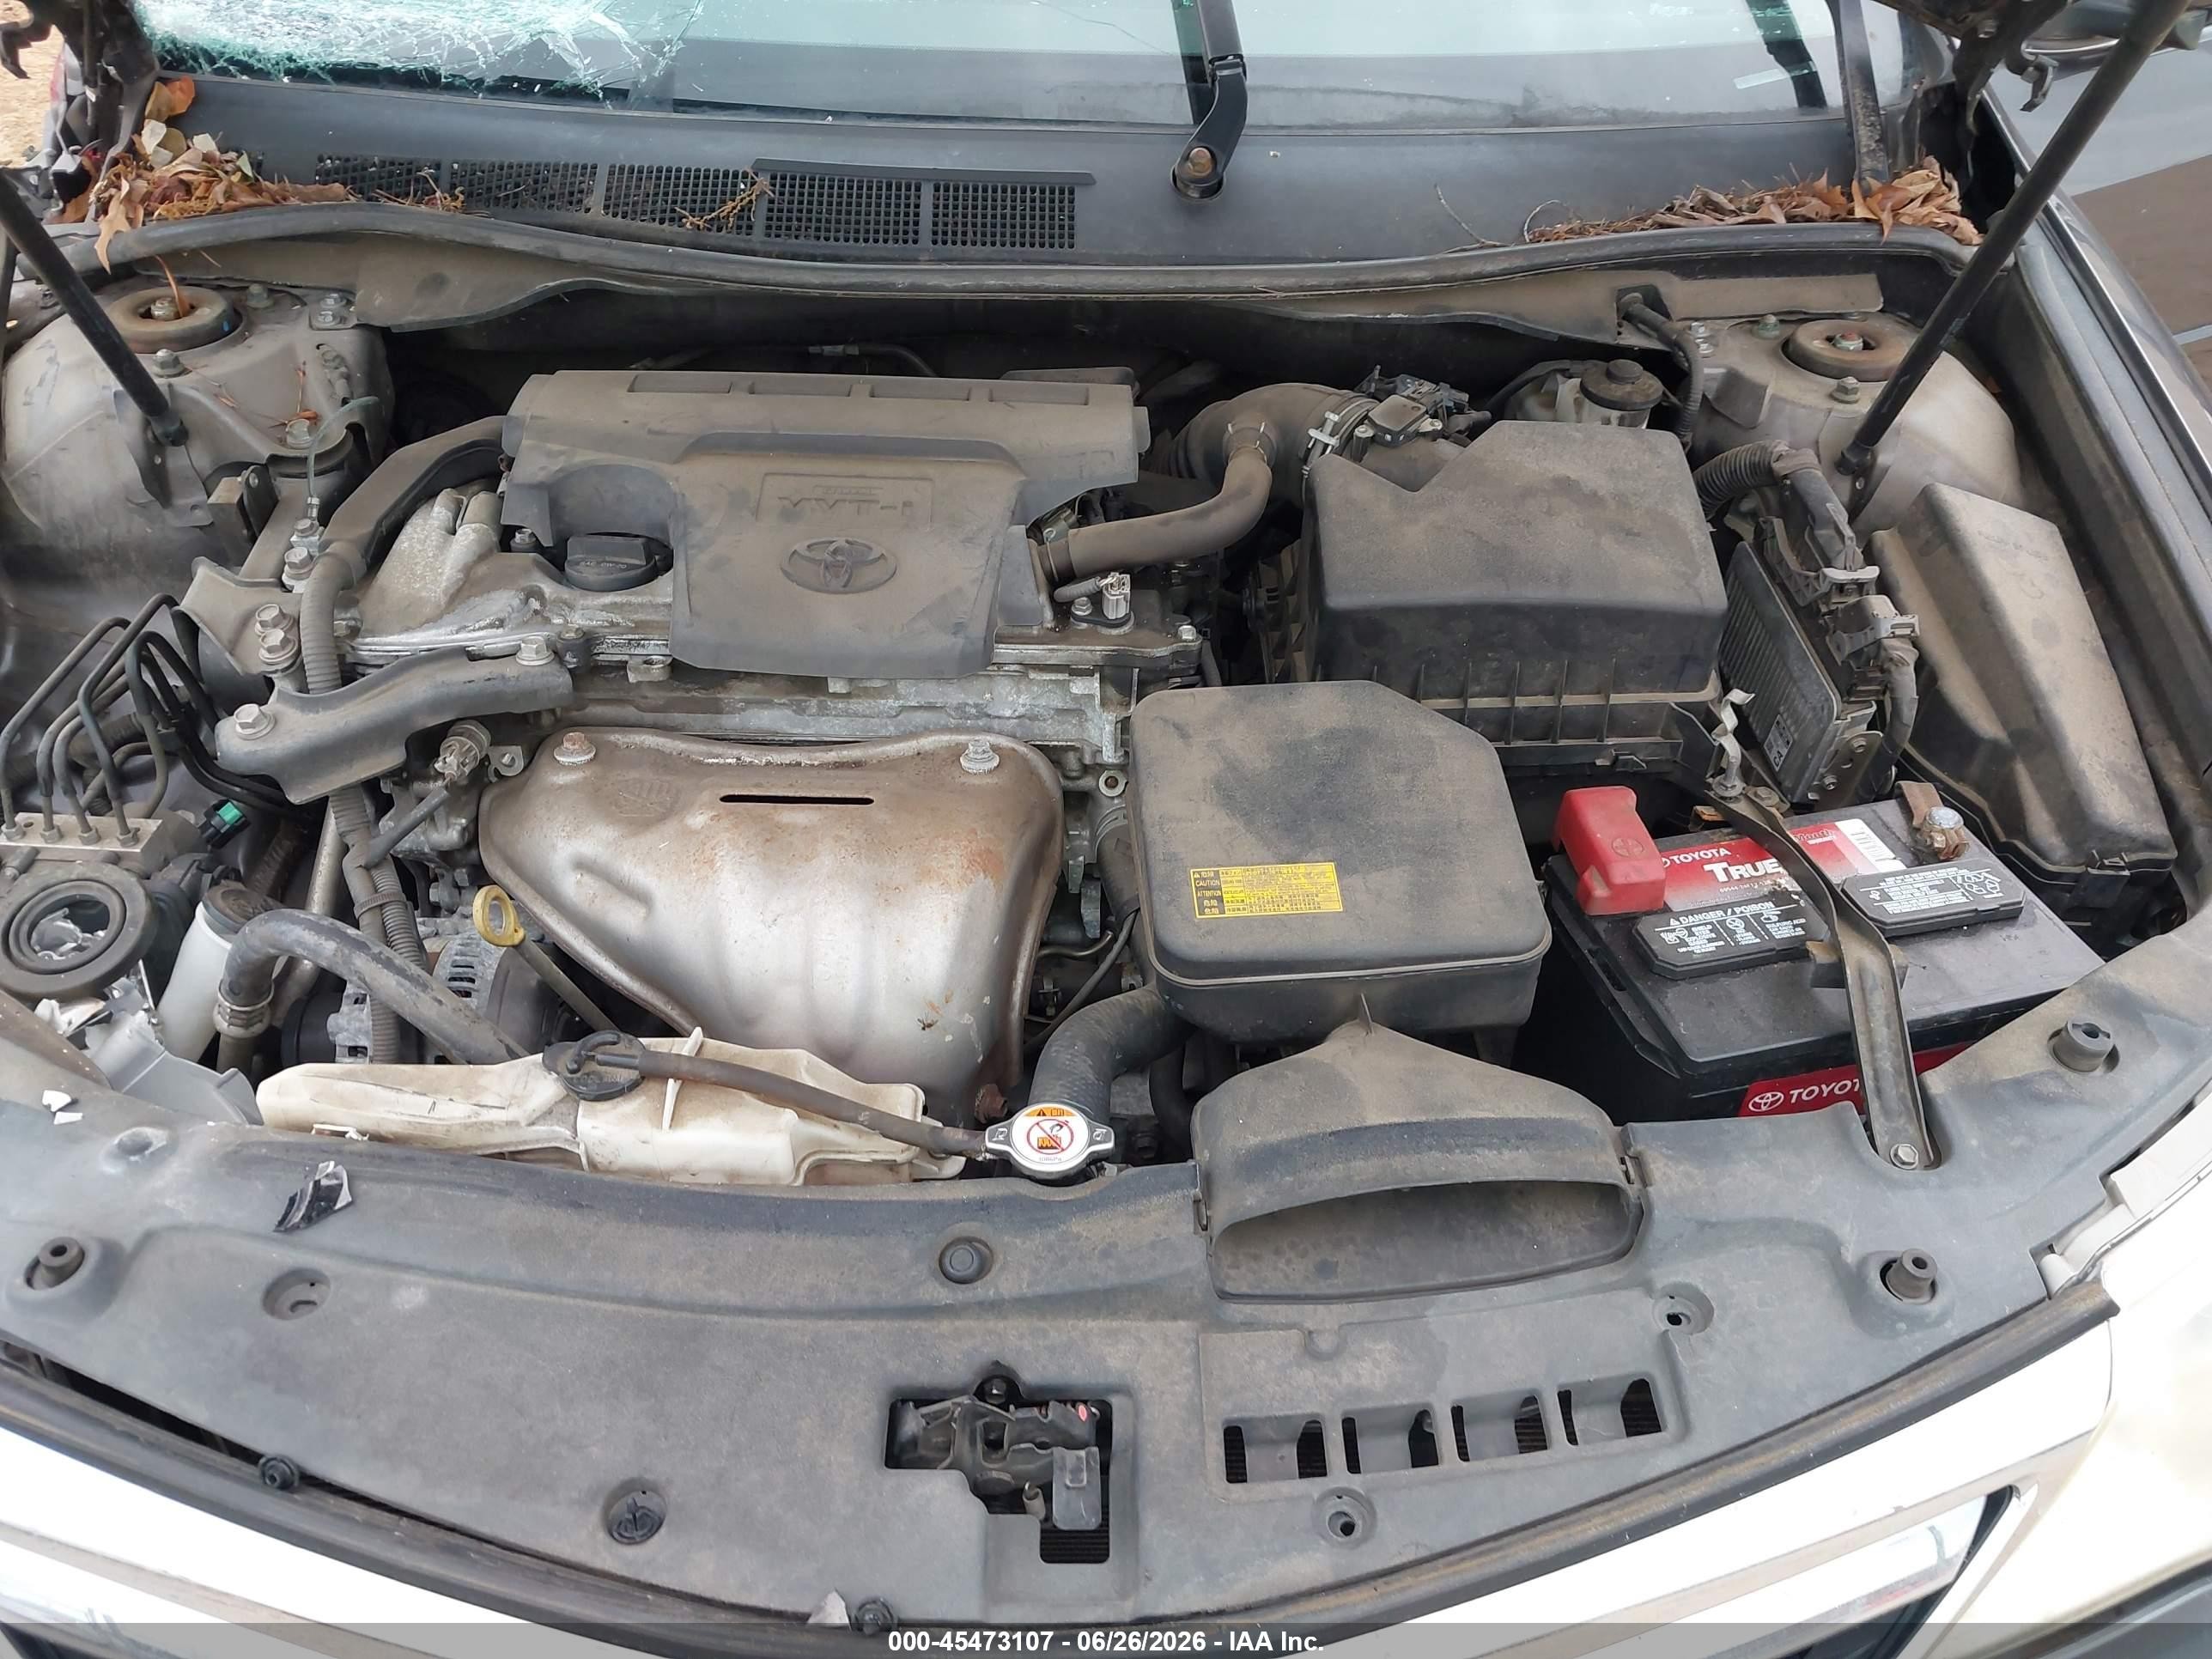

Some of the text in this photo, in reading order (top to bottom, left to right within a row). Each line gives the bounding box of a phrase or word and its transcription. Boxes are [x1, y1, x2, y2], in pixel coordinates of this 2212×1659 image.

[1669, 848, 1732, 865] TOYOTA
[1703, 858, 1781, 883] TRUE
[1679, 909, 1726, 925] DANGER
[1734, 901, 1776, 915] POISON
[1790, 1078, 1860, 1104] TOYOT
